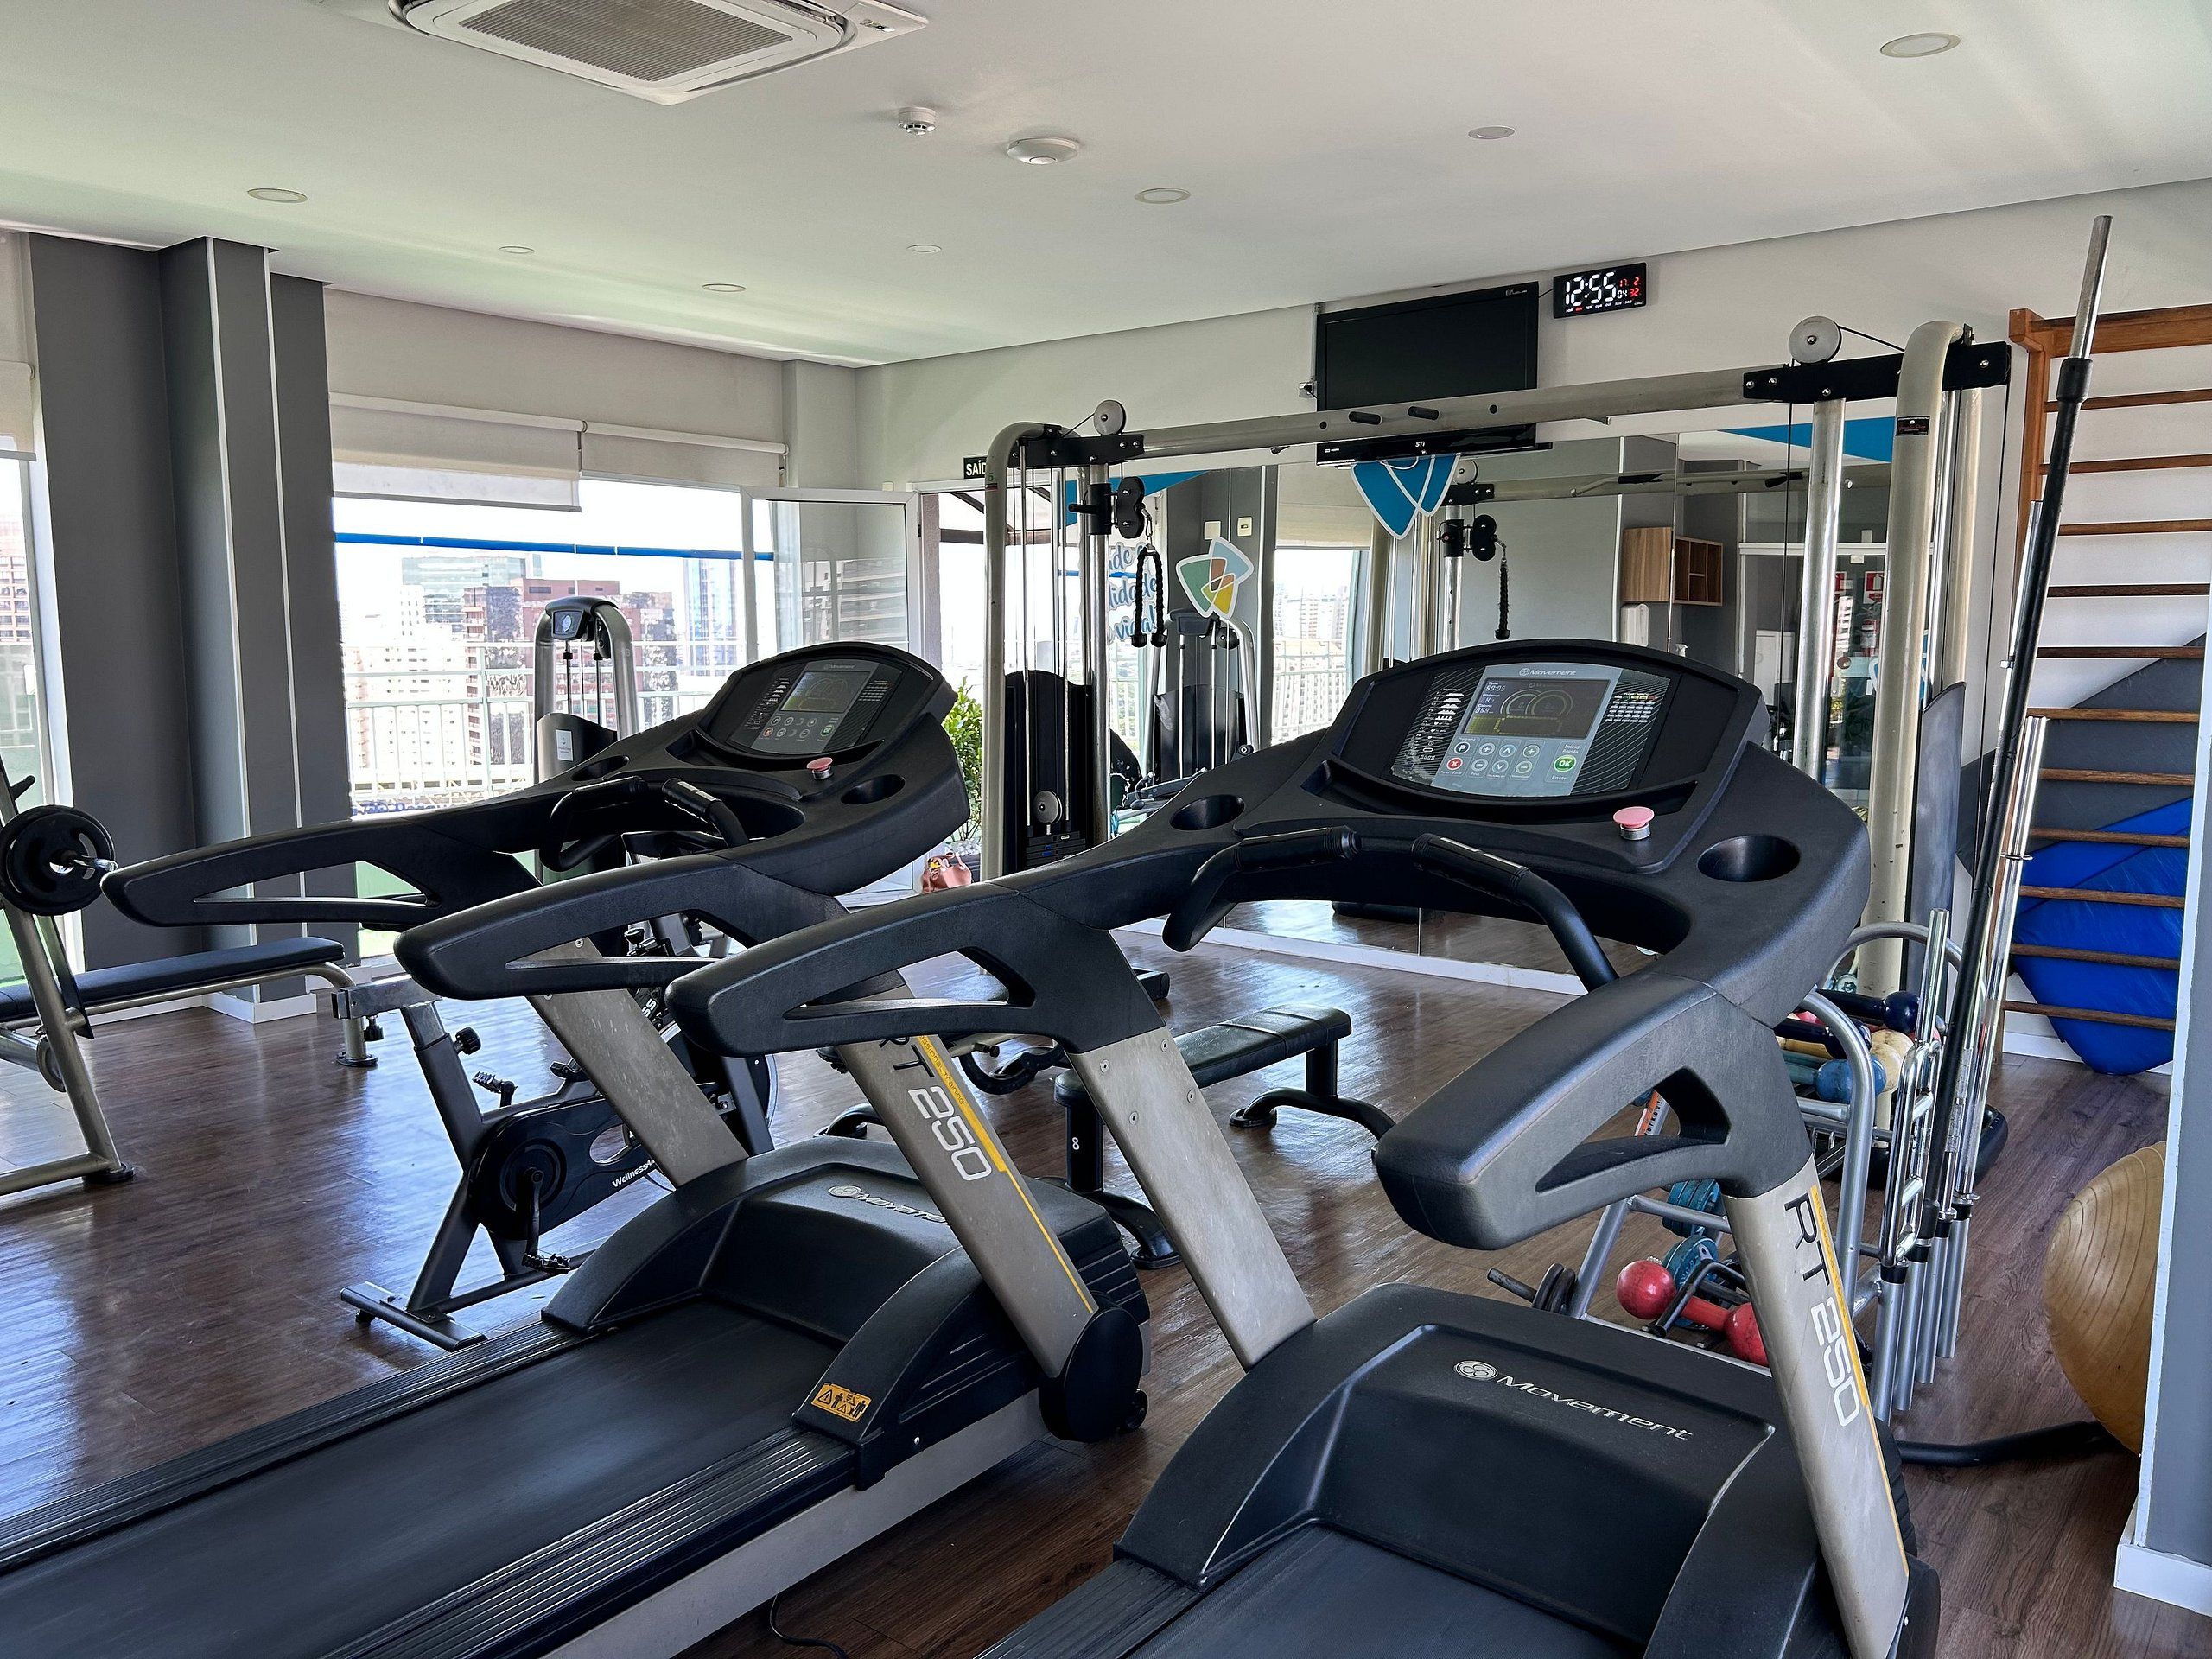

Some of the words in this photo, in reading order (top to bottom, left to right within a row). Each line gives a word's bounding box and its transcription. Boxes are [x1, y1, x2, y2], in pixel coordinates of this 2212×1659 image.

[1566, 271, 1616, 306] 12:55
[1617, 289, 1628, 299] 04
[965, 459, 987, 476] SAÍD
[907, 1085, 993, 1182] 250
[1071, 1136, 1080, 1150] 8
[858, 1192, 950, 1225] Moveme
[1784, 1192, 1831, 1287] RT
[1811, 1296, 1860, 1427] 250
[1497, 1375, 1694, 1441] Movement
